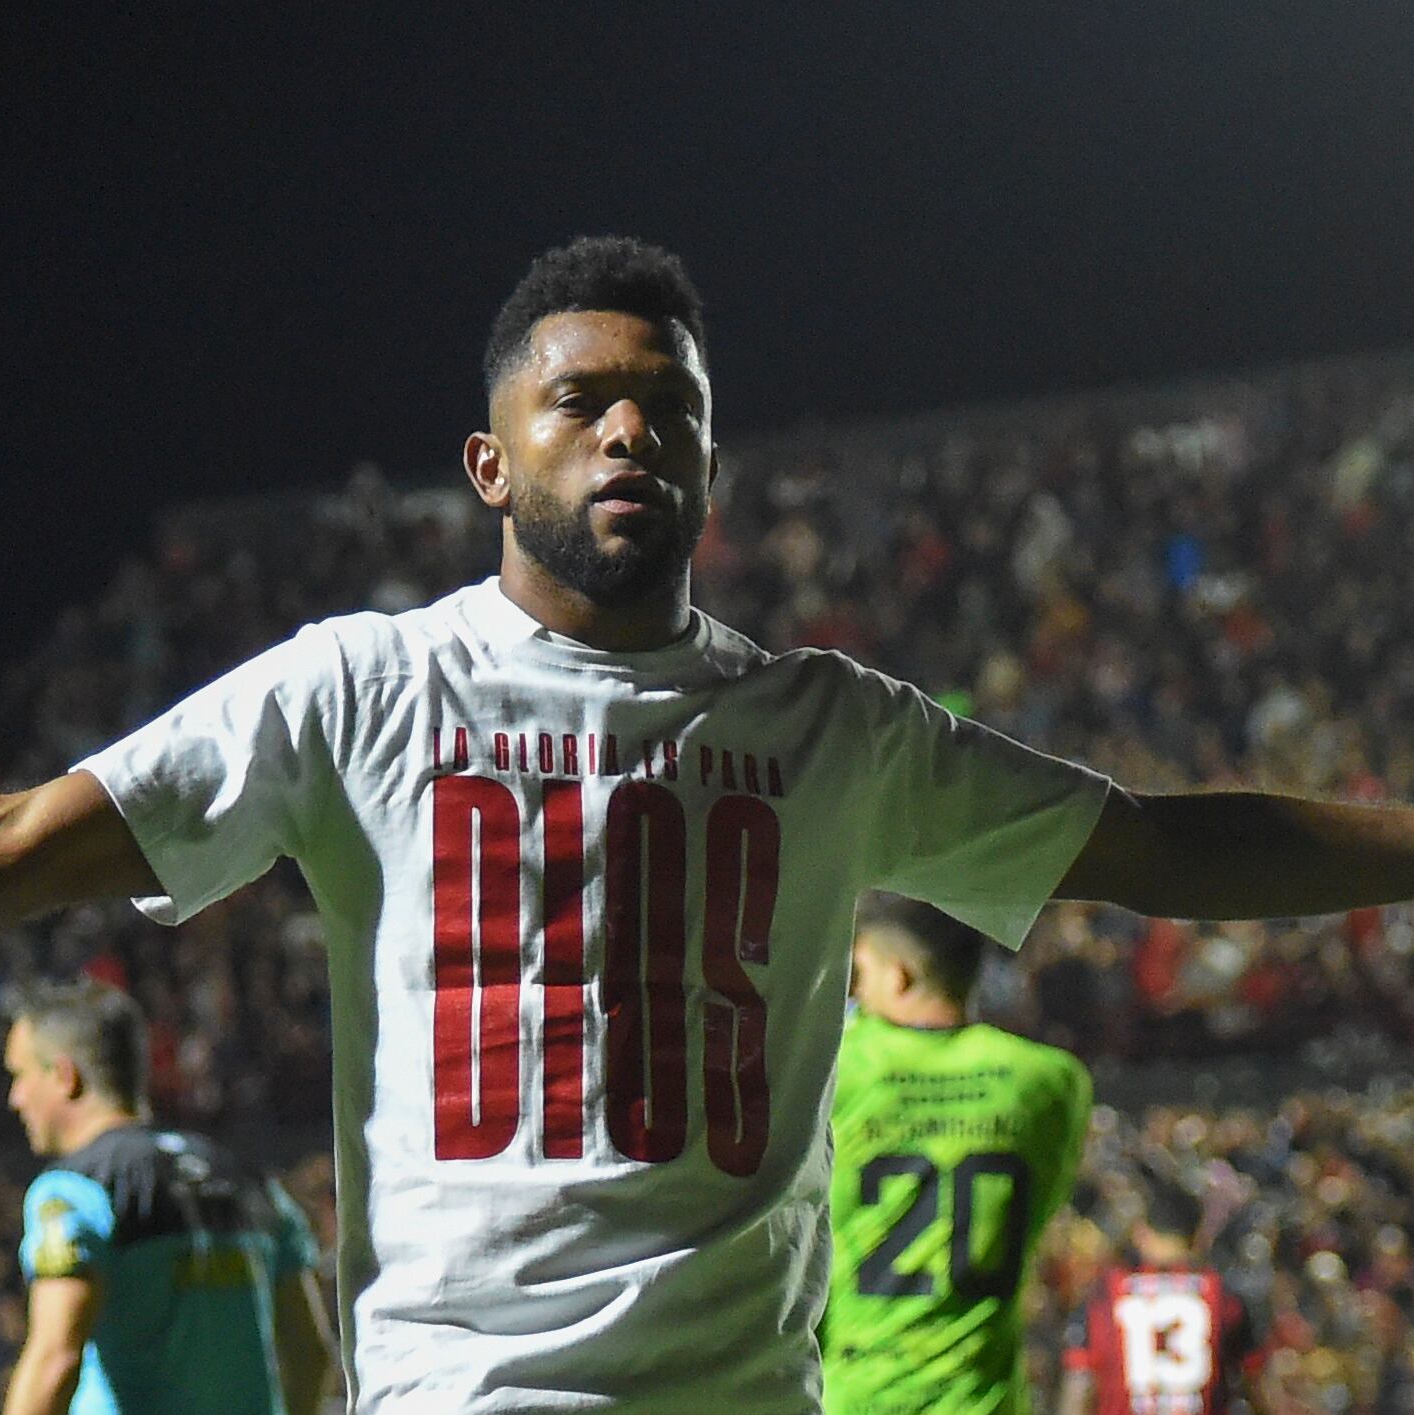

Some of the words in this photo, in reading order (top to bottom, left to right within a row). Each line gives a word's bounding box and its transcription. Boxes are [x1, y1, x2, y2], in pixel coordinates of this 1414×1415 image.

[433, 727, 469, 769] LA
[494, 732, 619, 776] GLORIA
[699, 744, 784, 798] PARA
[432, 775, 781, 1178] DIOS
[858, 1152, 1031, 1300] 20
[1115, 1296, 1213, 1392] 13
